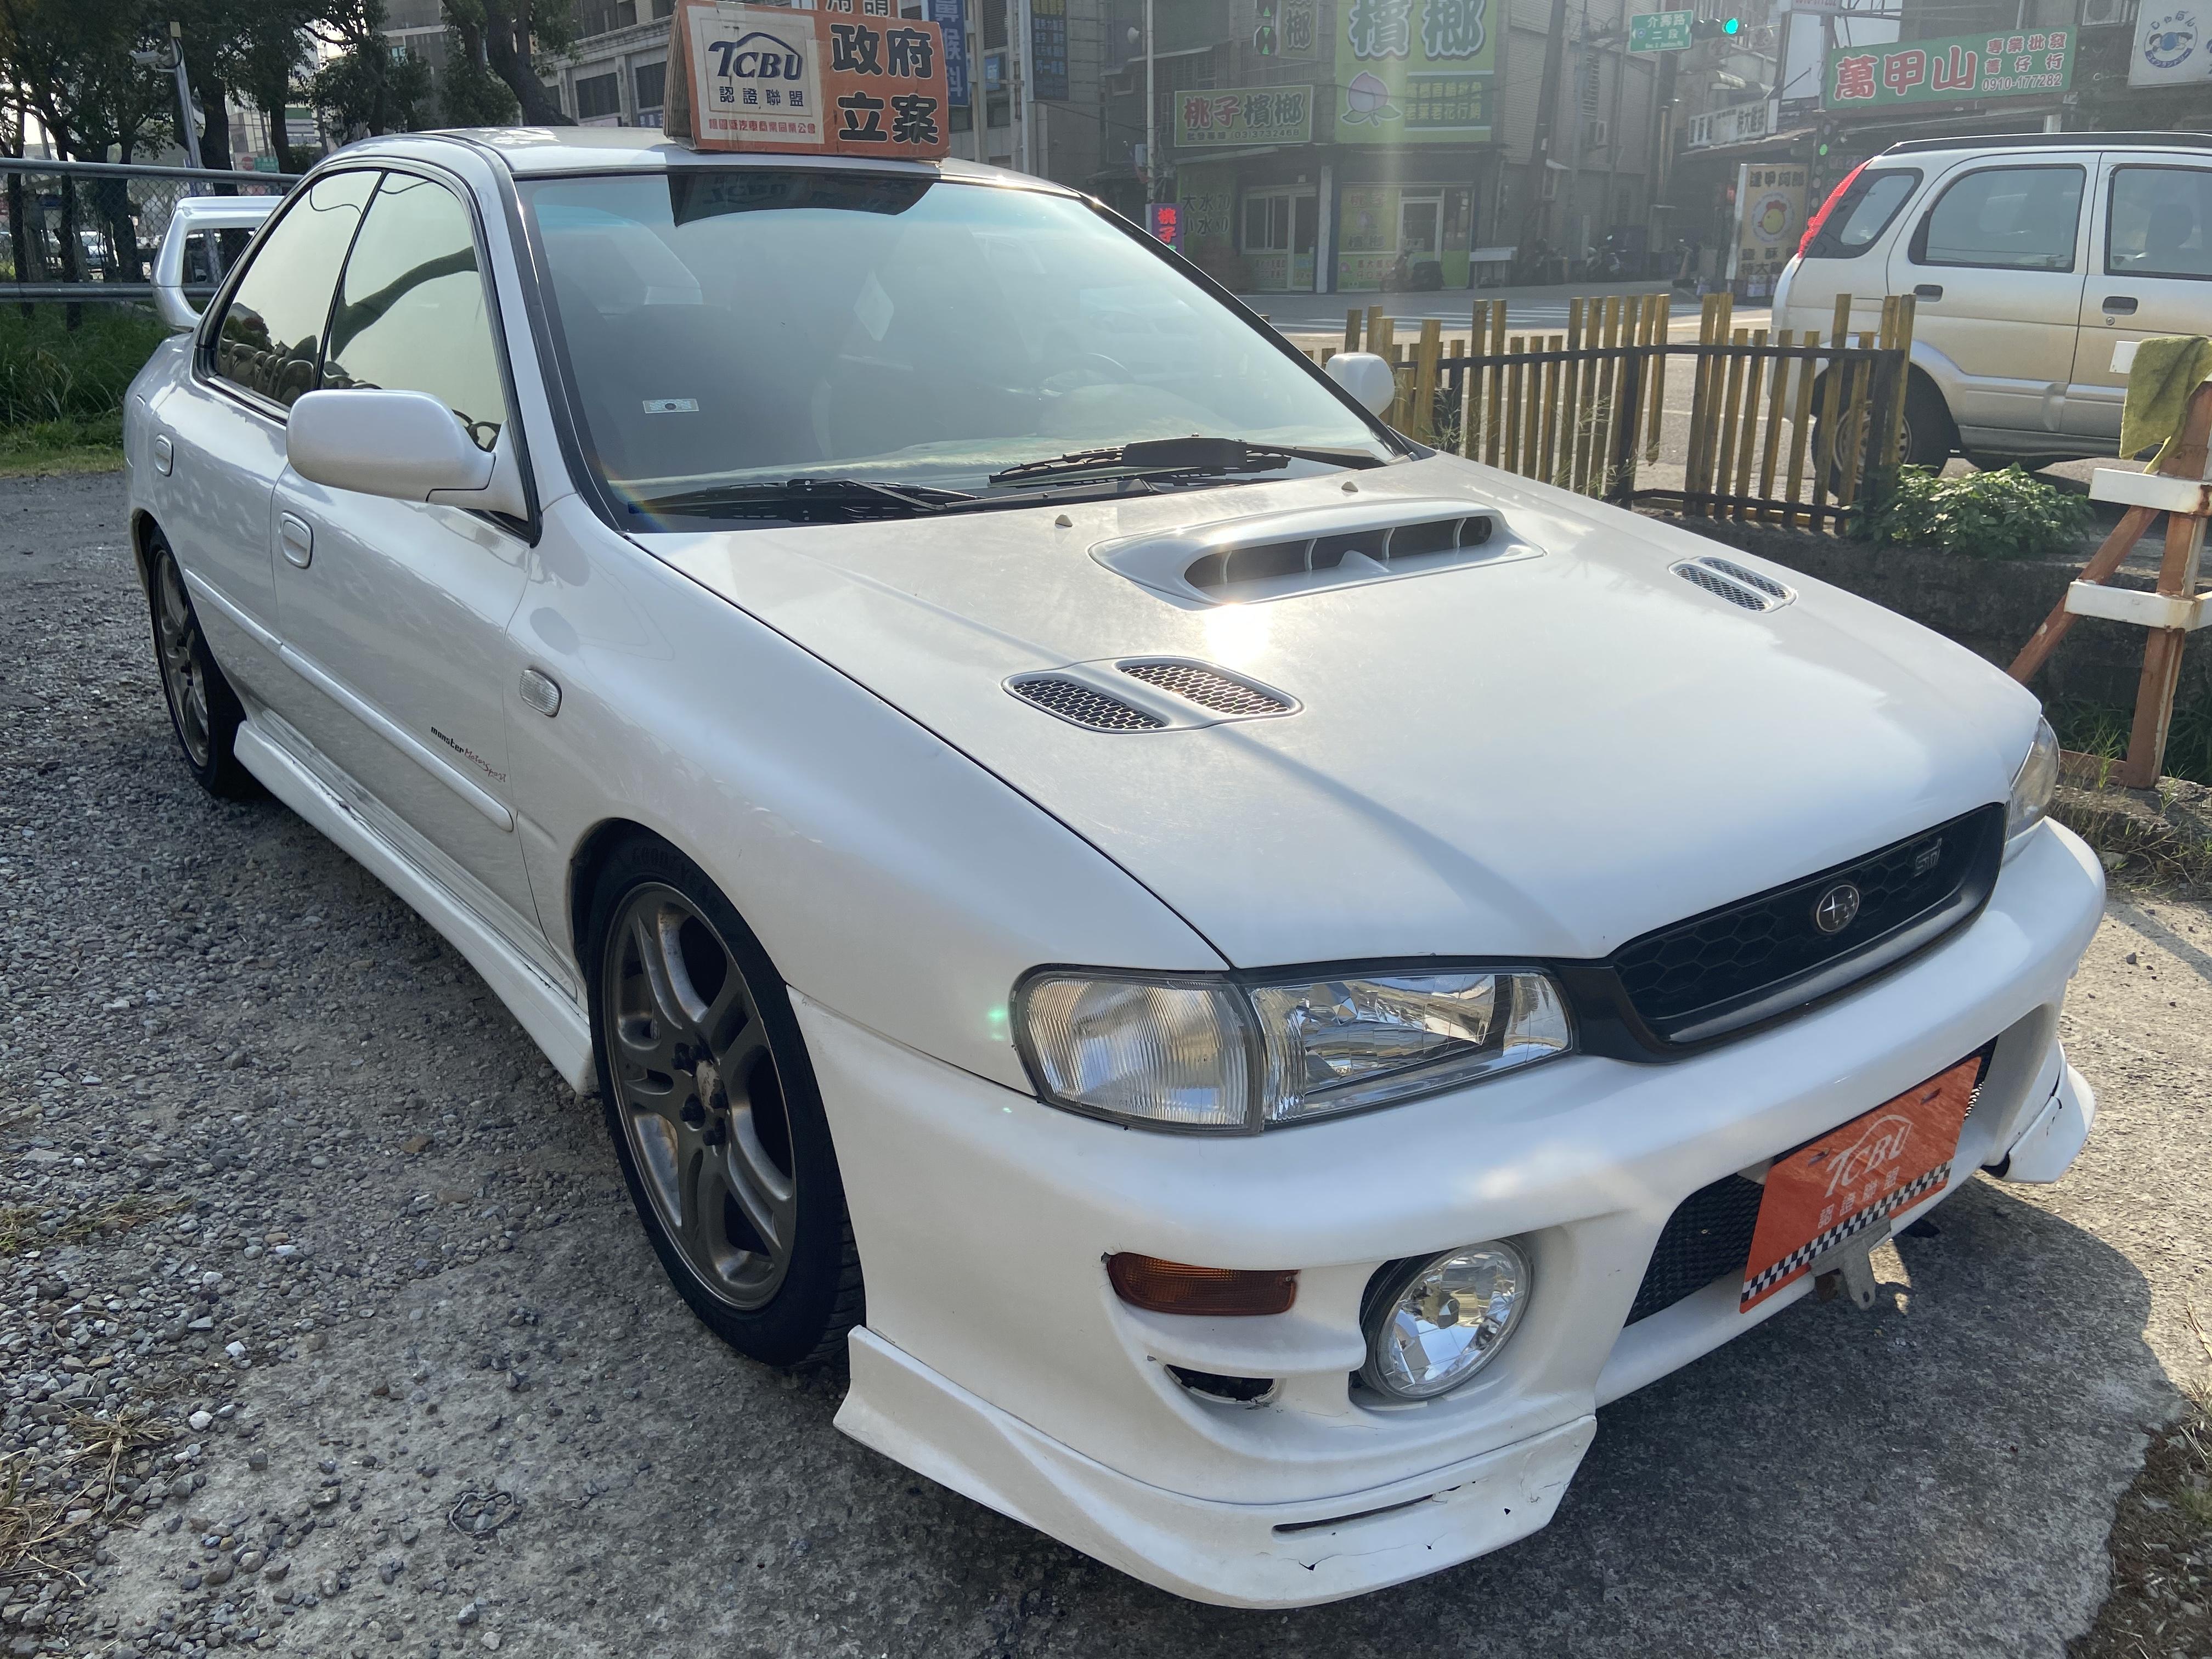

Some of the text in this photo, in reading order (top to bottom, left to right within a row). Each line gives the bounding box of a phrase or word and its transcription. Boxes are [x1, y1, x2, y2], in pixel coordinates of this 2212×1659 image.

[1285, 0, 1312, 49] 榔
[1348, 0, 1484, 58] 檳榔
[1652, 29, 1678, 40] 二段
[708, 32, 804, 81] TCBU
[830, 24, 934, 80] 政府
[1833, 45, 1978, 101] 萬甲山
[719, 86, 804, 106] 認證聯盟
[1982, 72, 2063, 91] 0910-177282
[838, 91, 939, 144] 立案
[1184, 92, 1304, 129] 桃子檳榔
[1158, 207, 1177, 251] 桃子
[431, 726, 464, 754] monster
[1825, 1114, 1914, 1198] TCBU
[1818, 1166, 1900, 1230] 認證聯盟
